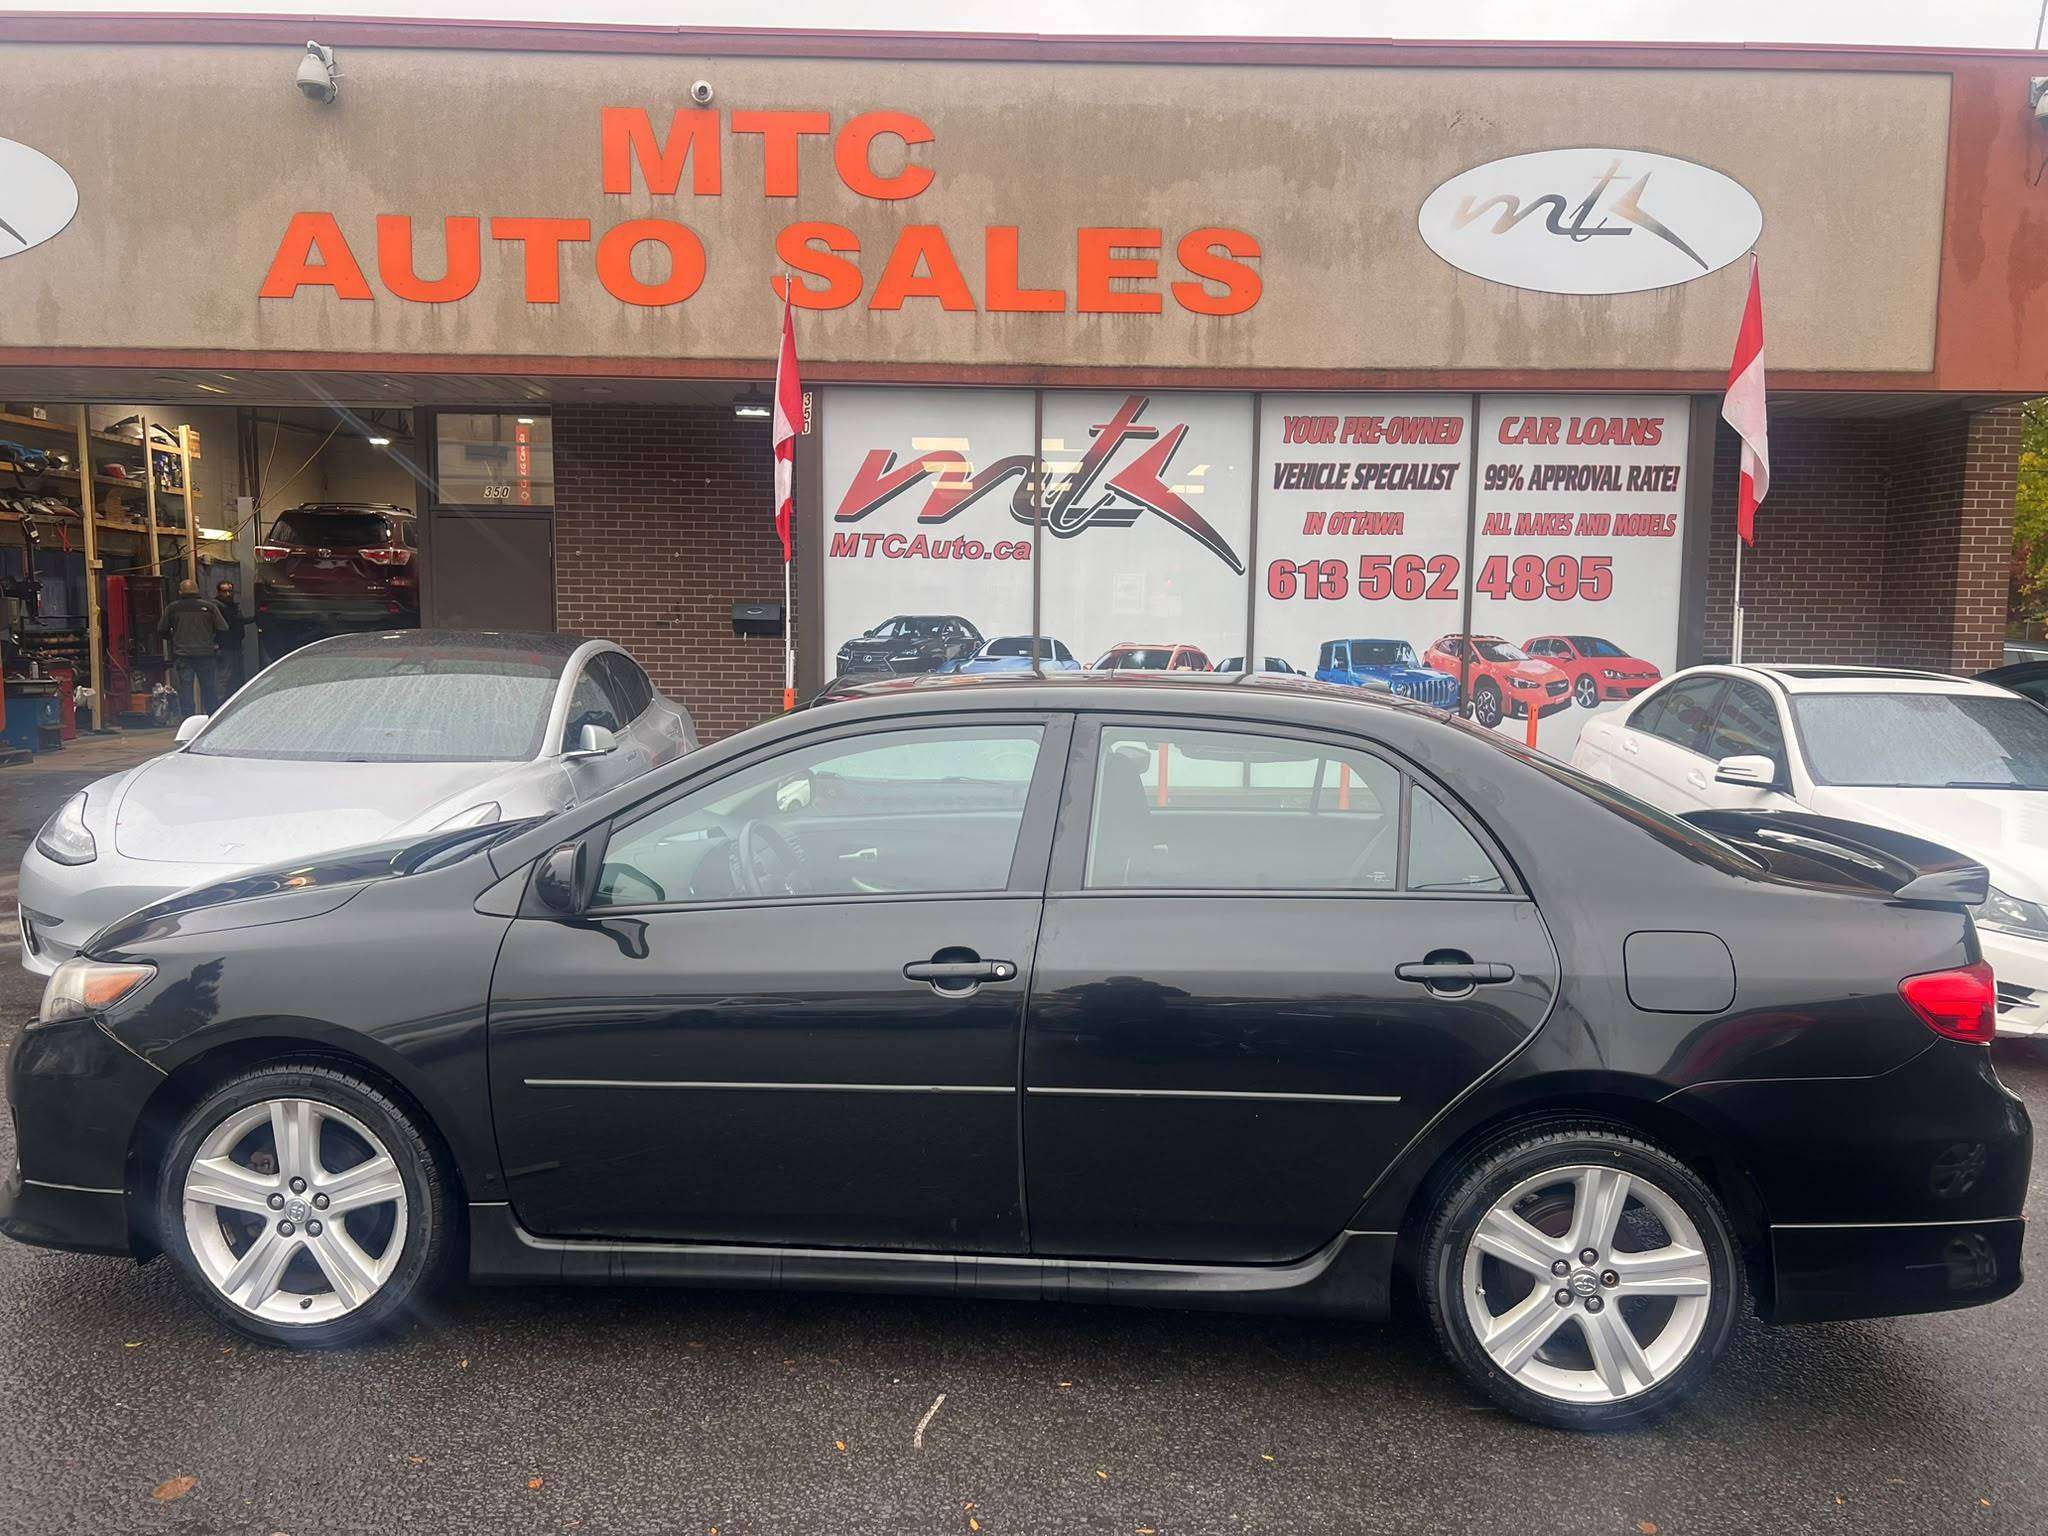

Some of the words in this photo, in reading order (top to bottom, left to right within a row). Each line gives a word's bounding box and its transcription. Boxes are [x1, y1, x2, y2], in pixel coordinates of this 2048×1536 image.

[601, 106, 936, 200] MTC
[258, 211, 707, 306] AUTO
[771, 220, 1263, 316] SALES
[1283, 416, 1339, 444] YOUR
[1340, 416, 1464, 445] PRE-OWNED
[1498, 416, 1562, 445] CAR
[1566, 417, 1665, 446] LOANS
[1273, 462, 1351, 490] VEHICLE
[1351, 462, 1461, 491] SPECIALIST
[1483, 464, 1525, 491] 99%
[1527, 464, 1623, 492] APPROVAL
[1626, 464, 1681, 492] RATE!
[483, 486, 510, 498] 350
[1302, 511, 1327, 535] IN
[1327, 511, 1404, 535] OTTAWA
[1482, 512, 1512, 536] ALL
[1514, 512, 1574, 536] MAKES
[1574, 513, 1611, 536] AND
[1612, 513, 1677, 537] MODELS
[829, 532, 1032, 561] MTCAuto.ca
[1267, 558, 1349, 600] 613
[1358, 554, 1461, 600] 562
[1476, 554, 1614, 601] 4895
